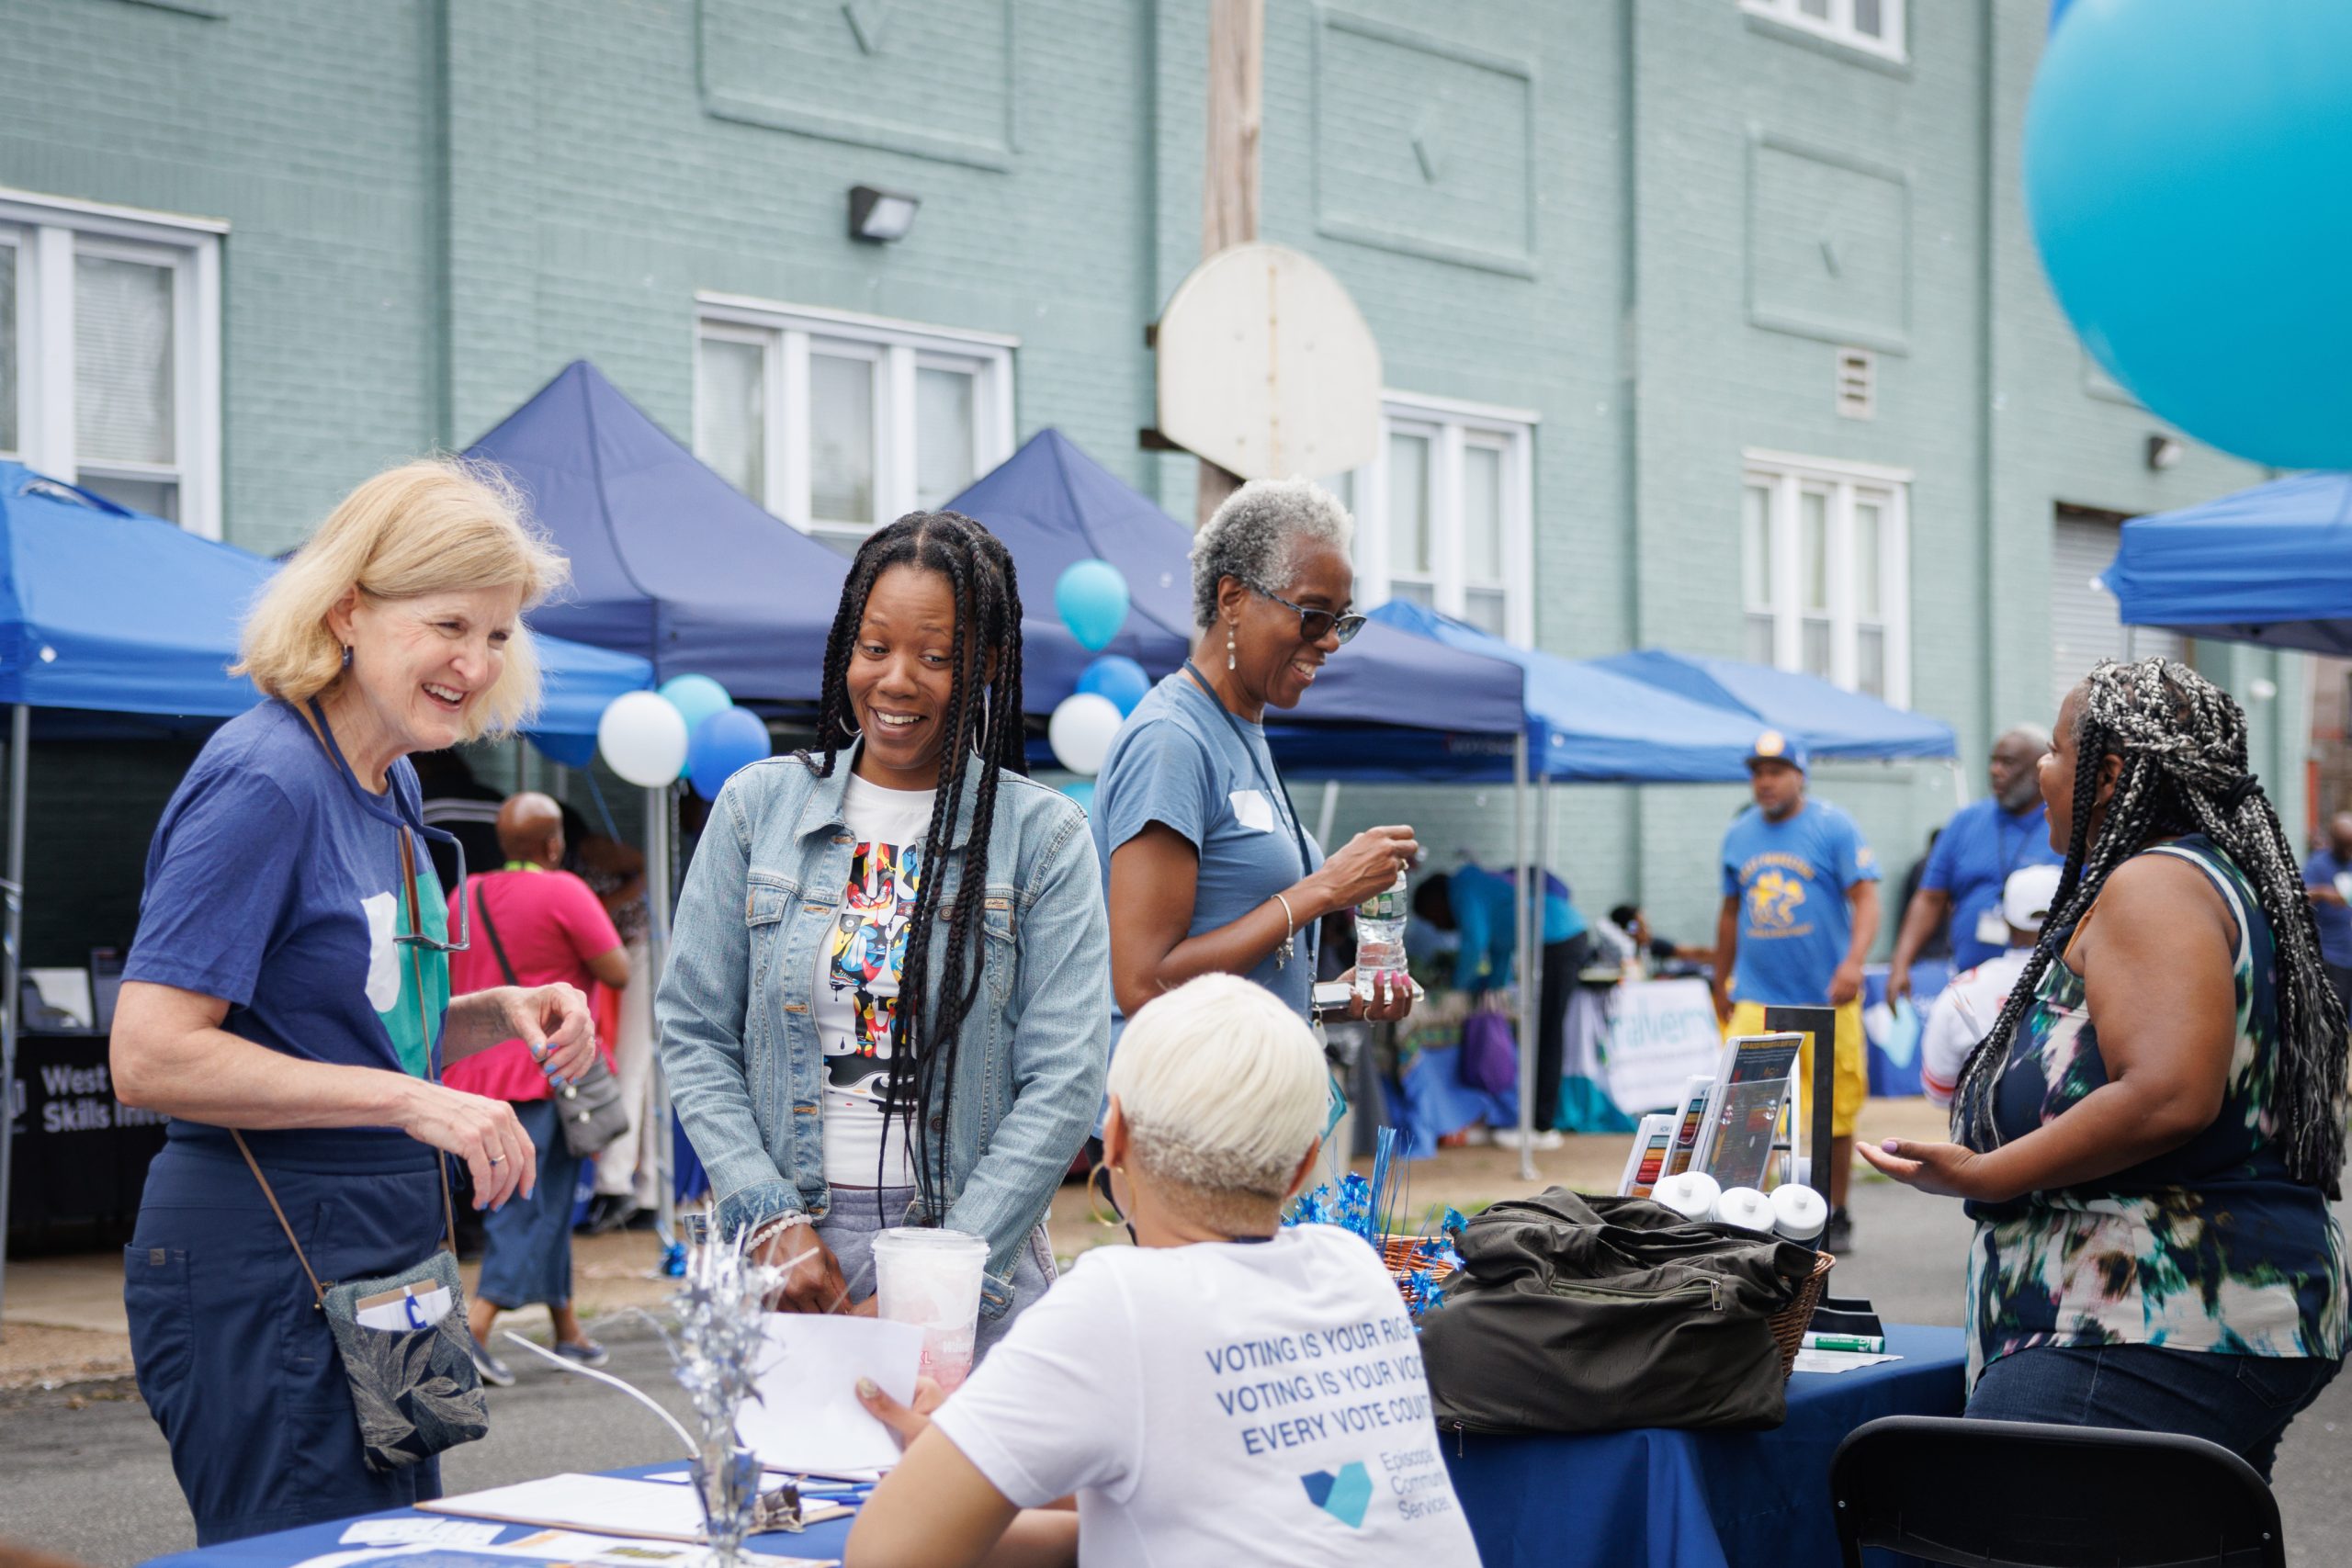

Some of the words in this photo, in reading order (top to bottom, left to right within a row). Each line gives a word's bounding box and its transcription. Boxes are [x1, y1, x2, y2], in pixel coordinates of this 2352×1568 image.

[41, 1064, 108, 1096] West
[42, 1098, 111, 1134] Skills
[1205, 1337, 1297, 1375] VOTING
[1300, 1334, 1321, 1359] IS
[1323, 1323, 1379, 1355] YOUR
[1216, 1376, 1315, 1416] VOTING
[1317, 1371, 1340, 1395] IS
[1340, 1361, 1395, 1391] YOUR
[1241, 1414, 1329, 1456] EVERY
[1331, 1403, 1390, 1434] VOTE
